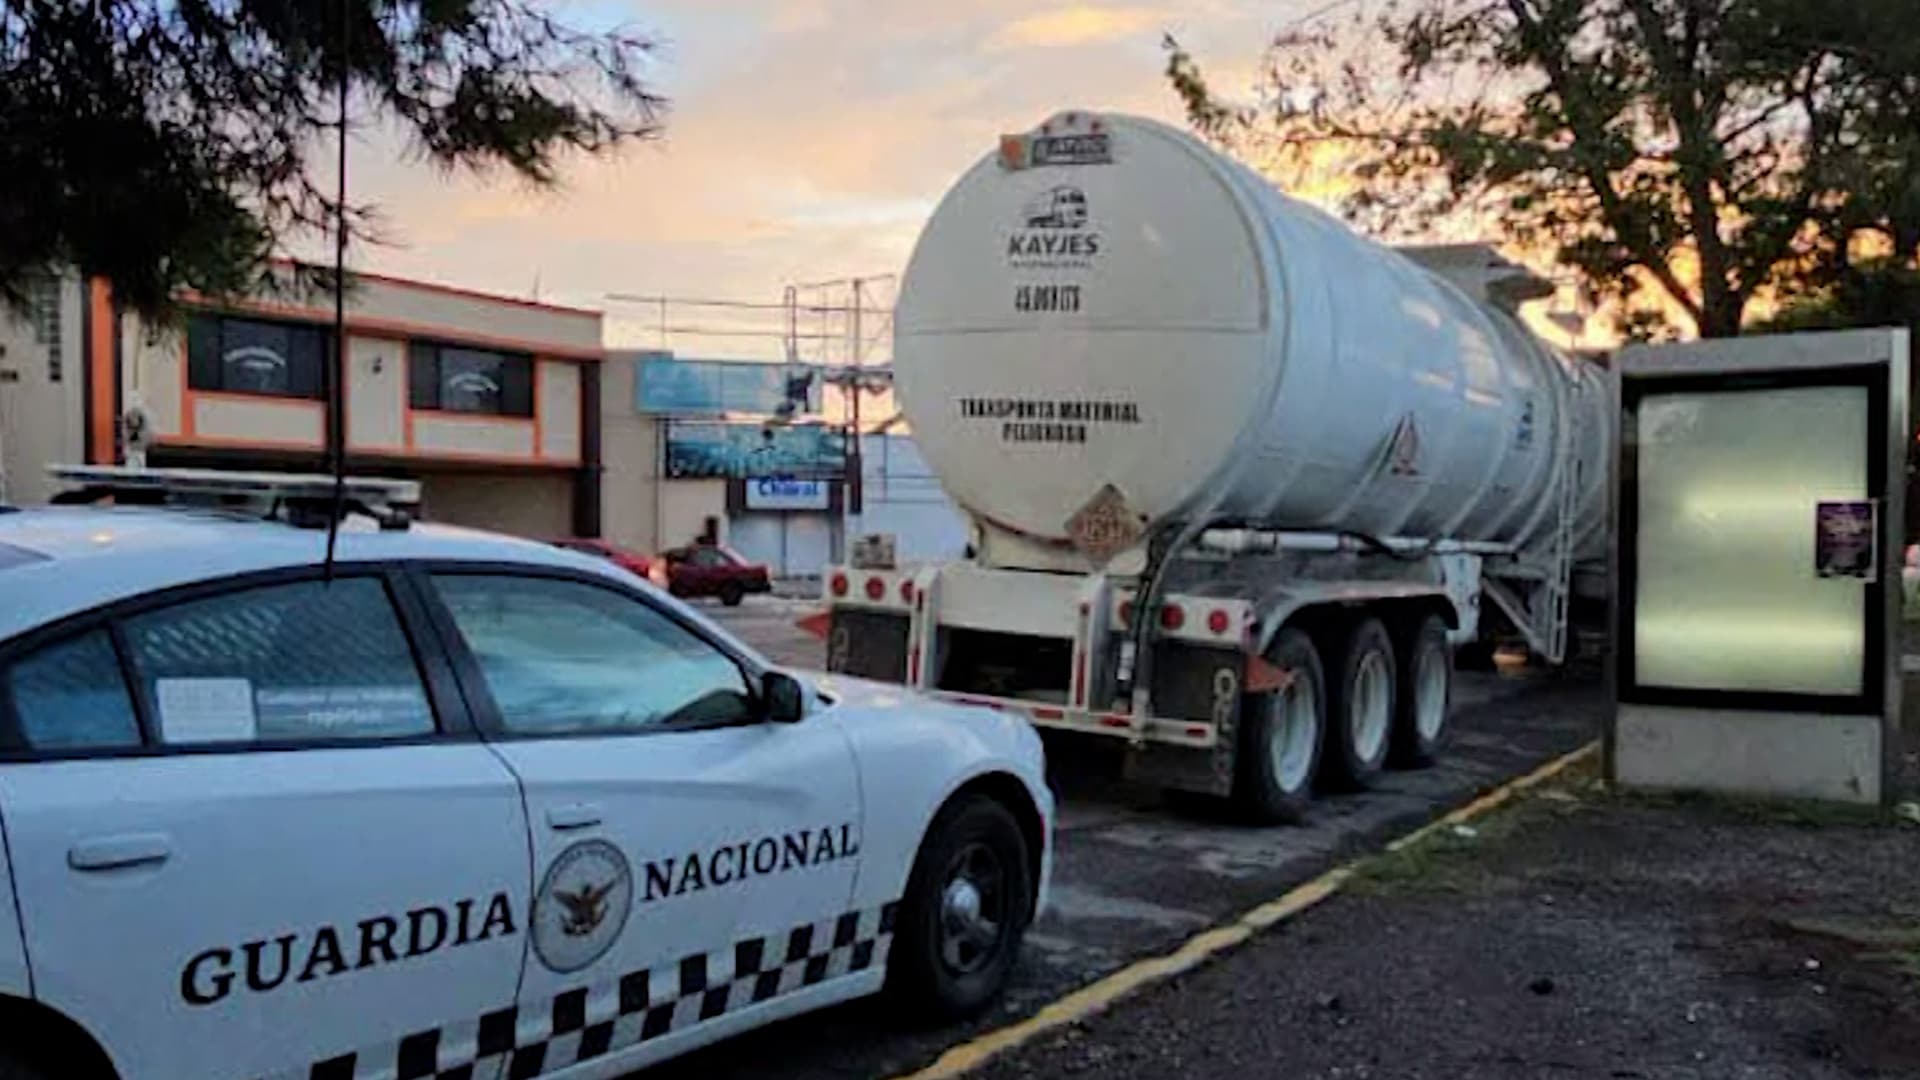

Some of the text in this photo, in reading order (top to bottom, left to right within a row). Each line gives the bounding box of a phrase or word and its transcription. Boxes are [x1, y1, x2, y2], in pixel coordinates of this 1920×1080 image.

[1008, 233, 1099, 256] KAYJES
[1058, 400, 1141, 423] MATERIAL
[179, 892, 518, 1006] GUARDIA
[639, 822, 861, 902] NACIONAL
